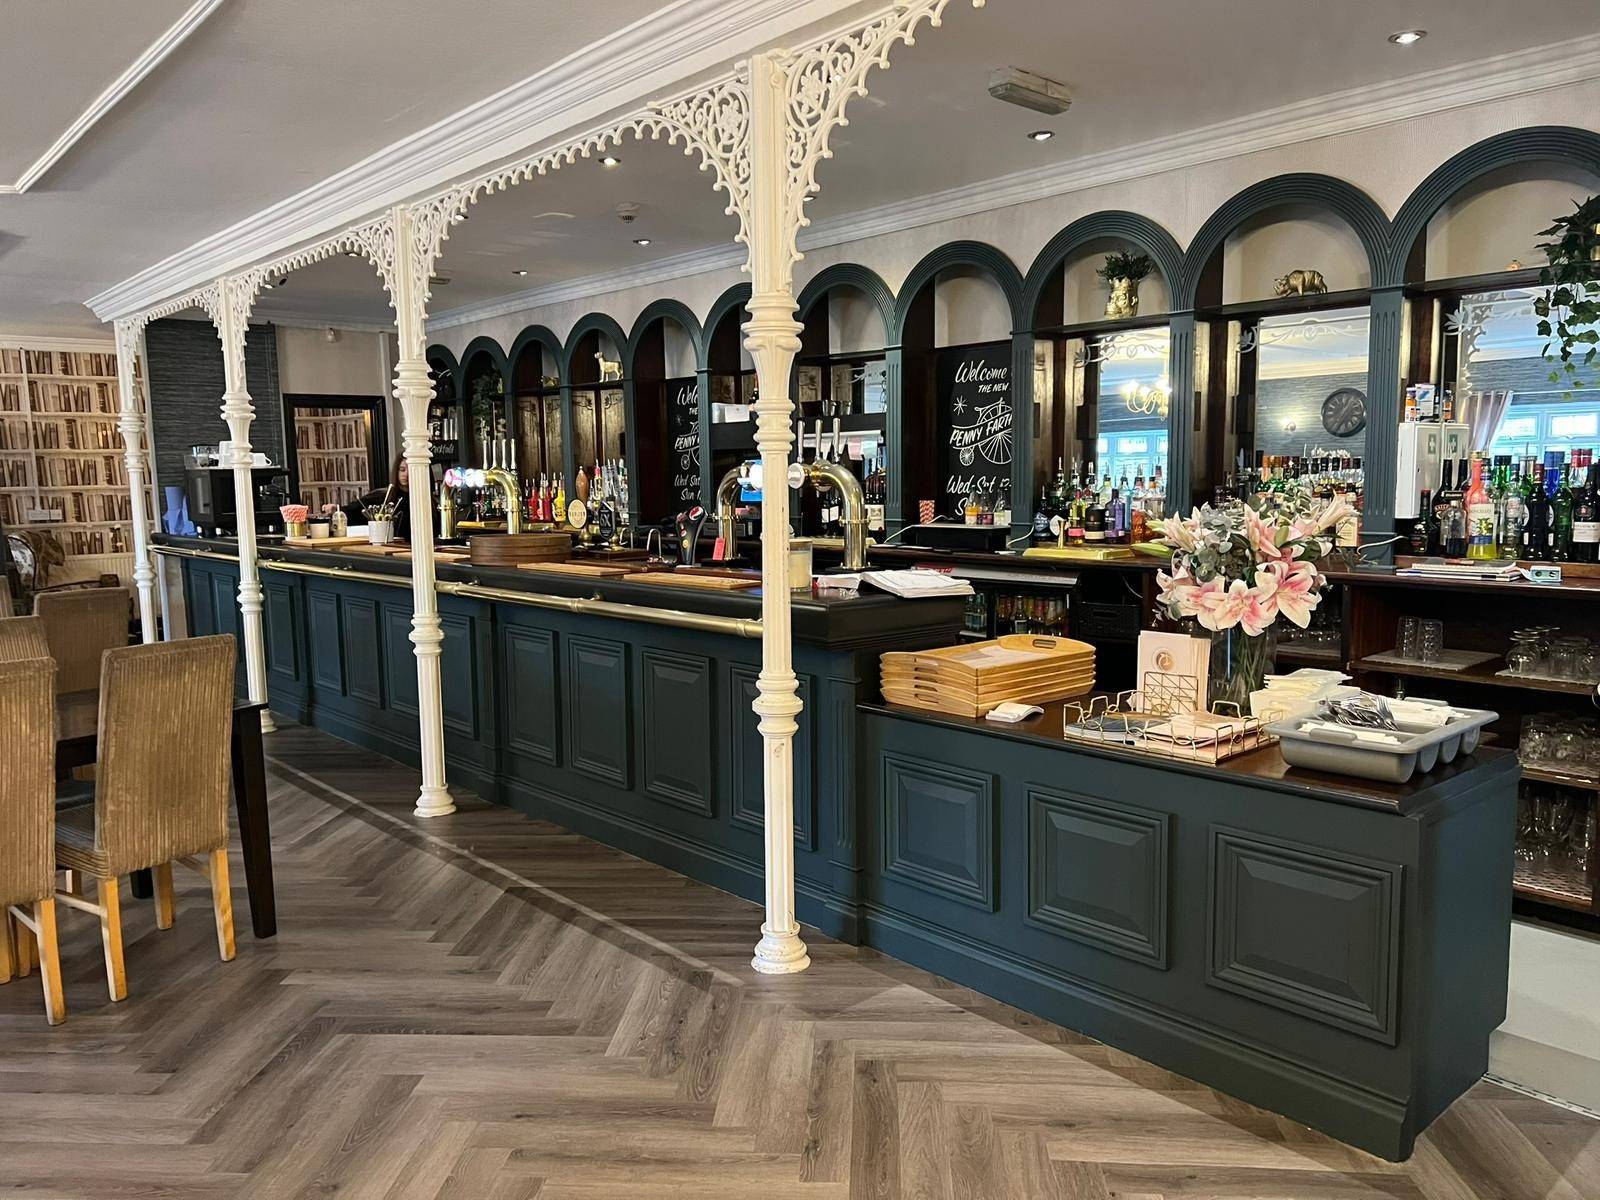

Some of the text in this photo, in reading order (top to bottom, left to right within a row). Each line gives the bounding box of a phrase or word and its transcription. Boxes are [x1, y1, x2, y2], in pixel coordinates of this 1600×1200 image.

[955, 360, 1007, 383] Welcome
[978, 382, 1009, 394] THE NEW
[674, 435, 697, 450] PENNY
[950, 427, 983, 446] PENNY
